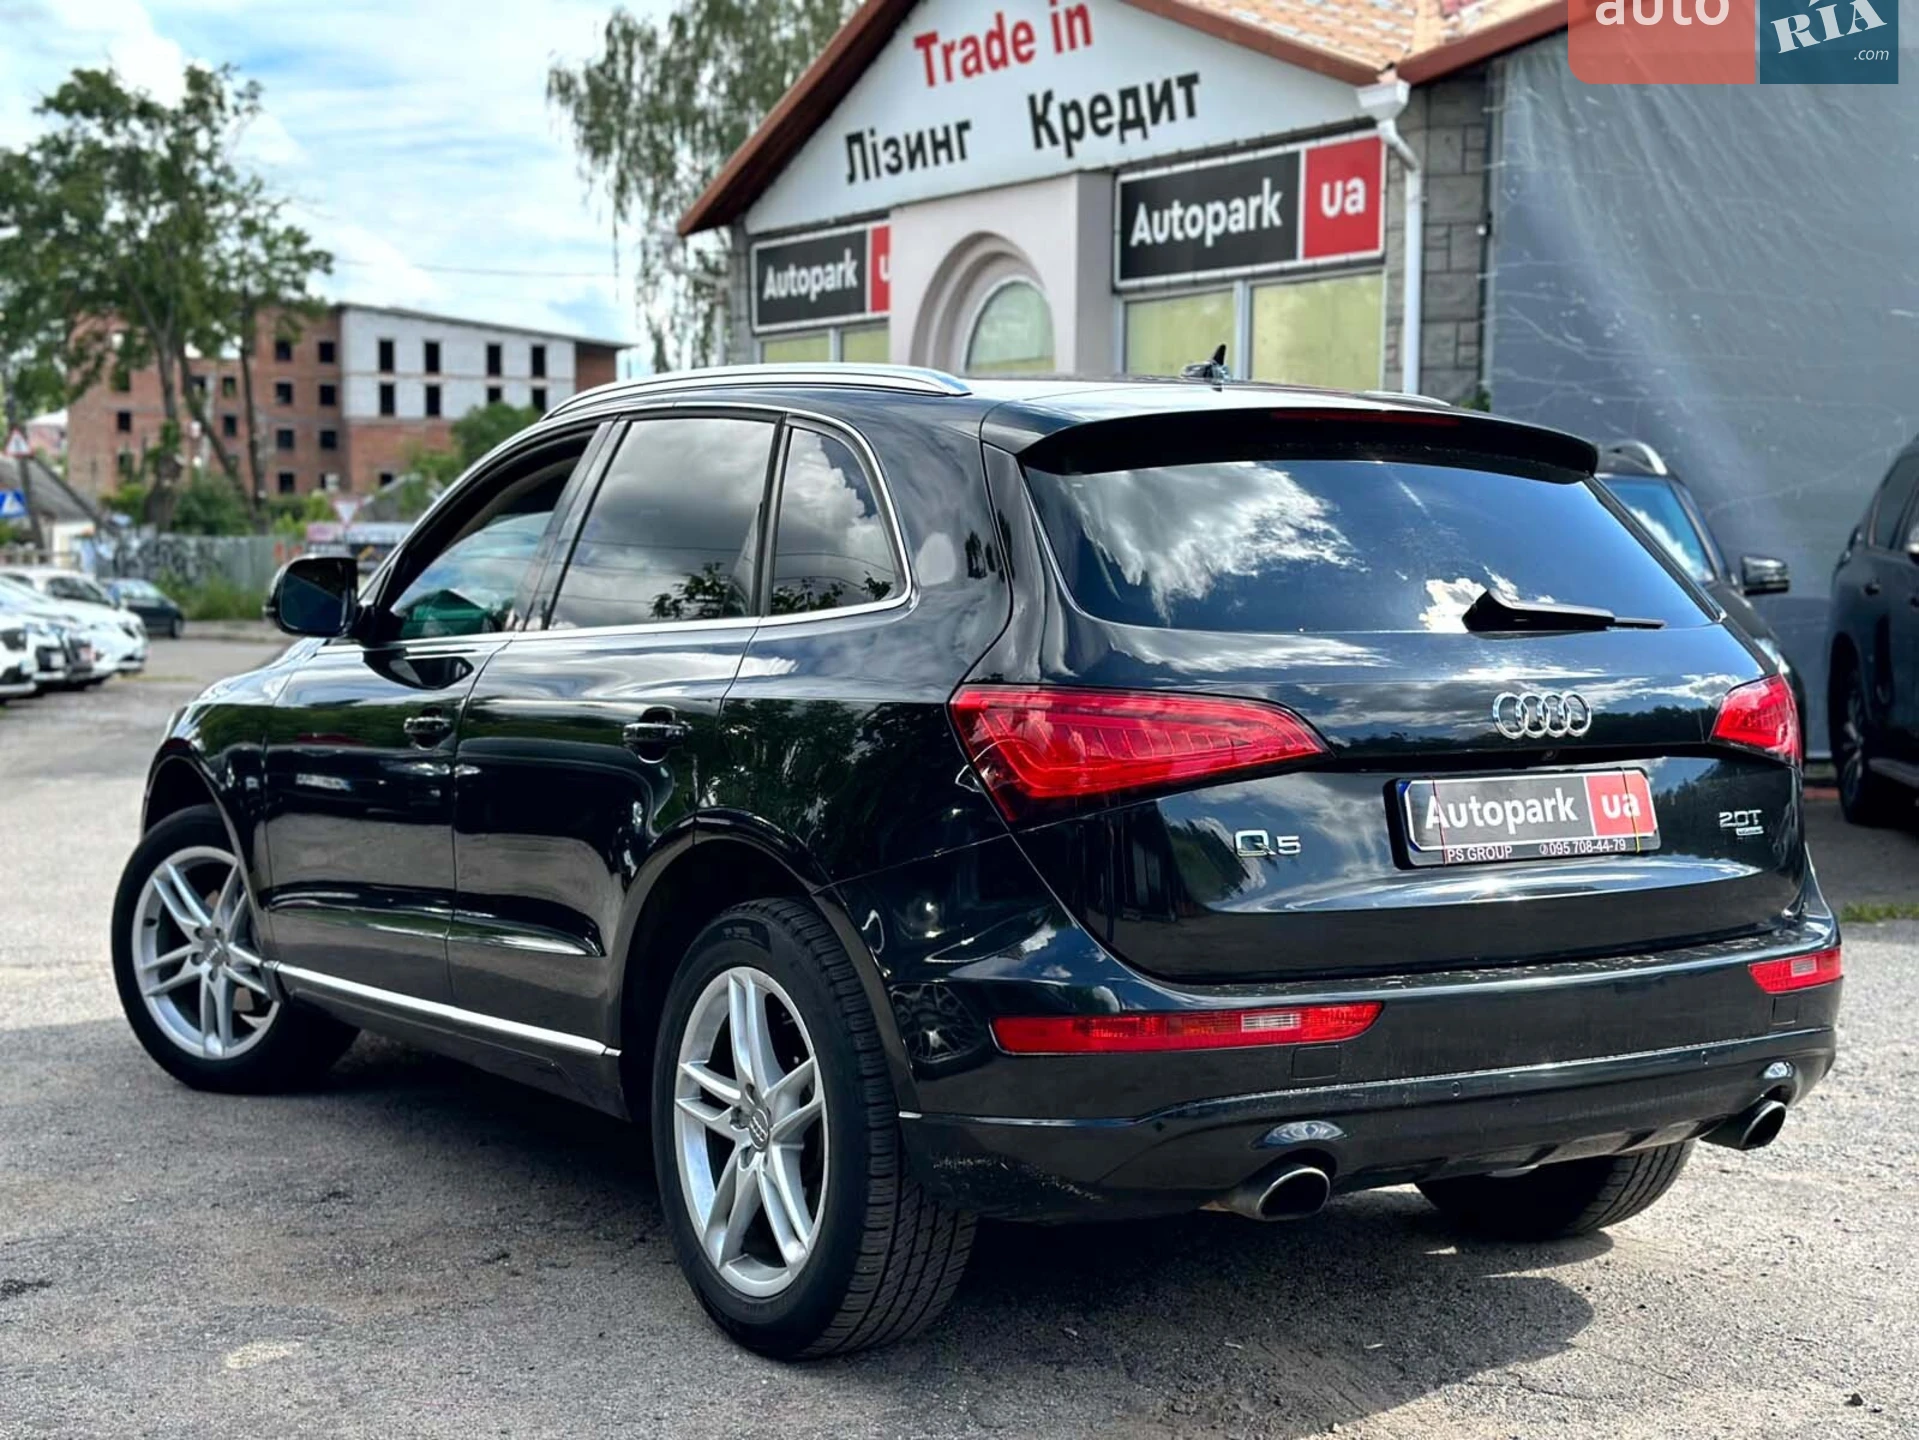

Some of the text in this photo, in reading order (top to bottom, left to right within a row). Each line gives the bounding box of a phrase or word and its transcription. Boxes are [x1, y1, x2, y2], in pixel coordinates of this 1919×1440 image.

[913, 0, 1092, 88] Trade in
[845, 71, 1201, 184] Лізинг Кредит
[1130, 176, 1366, 247] Autopark ua
[763, 247, 858, 303] Autopark
[1425, 787, 1642, 835] Autopark ua
[1447, 845, 1513, 863] PS GROUP
[1549, 838, 1626, 855] 095 708-44-79
